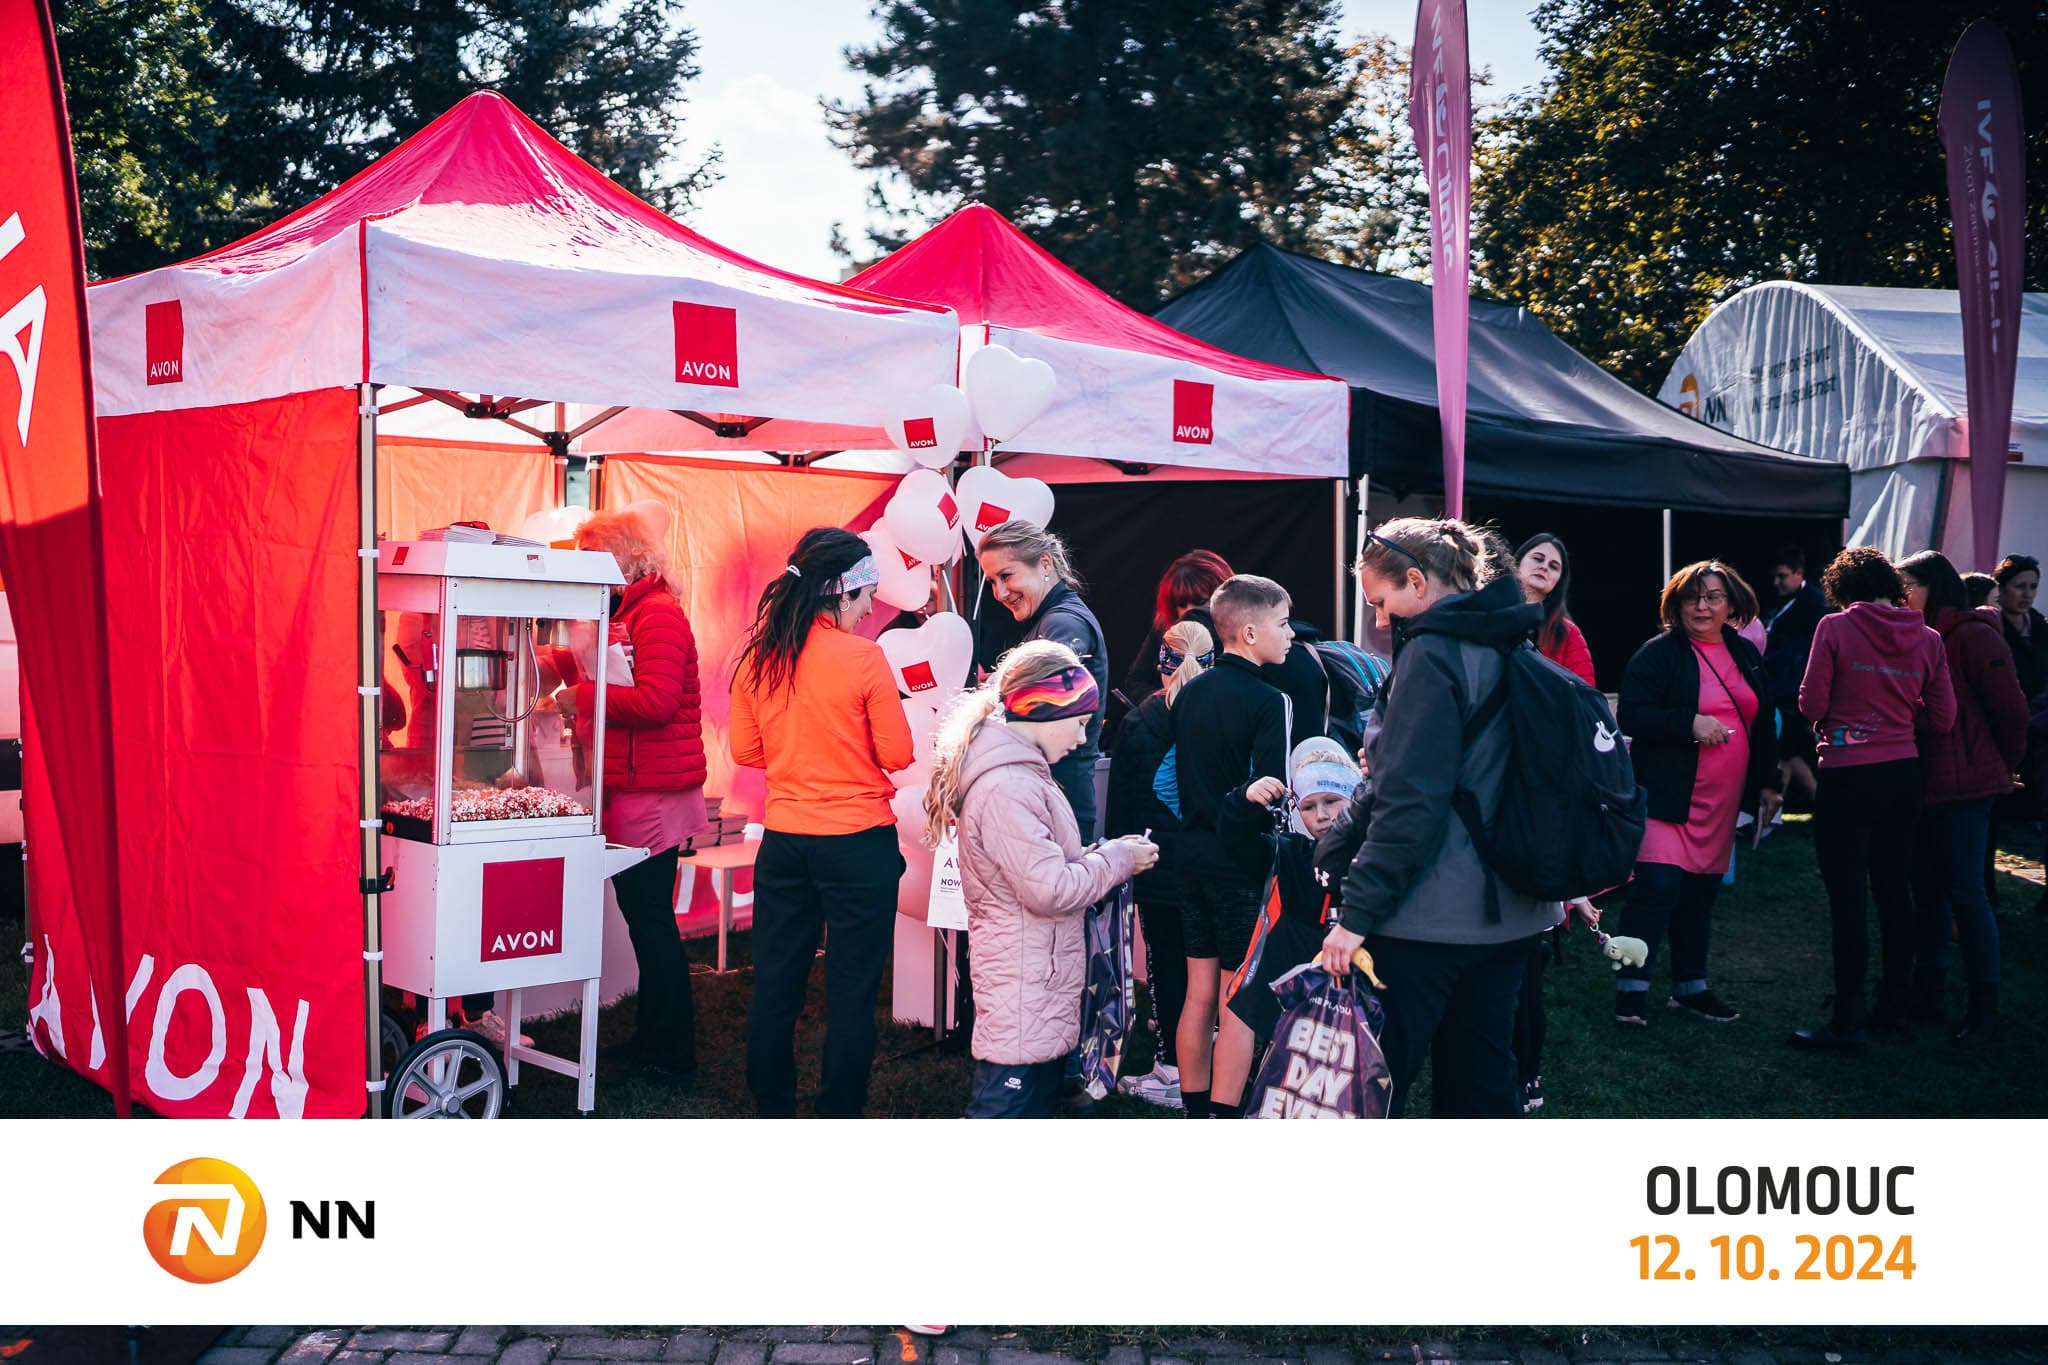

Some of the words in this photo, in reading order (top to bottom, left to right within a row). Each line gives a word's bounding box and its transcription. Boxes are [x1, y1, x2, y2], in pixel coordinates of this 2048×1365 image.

[1977, 99, 1994, 175] IVF
[150, 359, 179, 378] AVON
[681, 360, 731, 381] AVON
[1175, 424, 1209, 439] AVON
[910, 438, 934, 448] AVON
[911, 681, 934, 691] AVON
[490, 929, 554, 953] AVON
[1284, 1053, 1354, 1106] DAY
